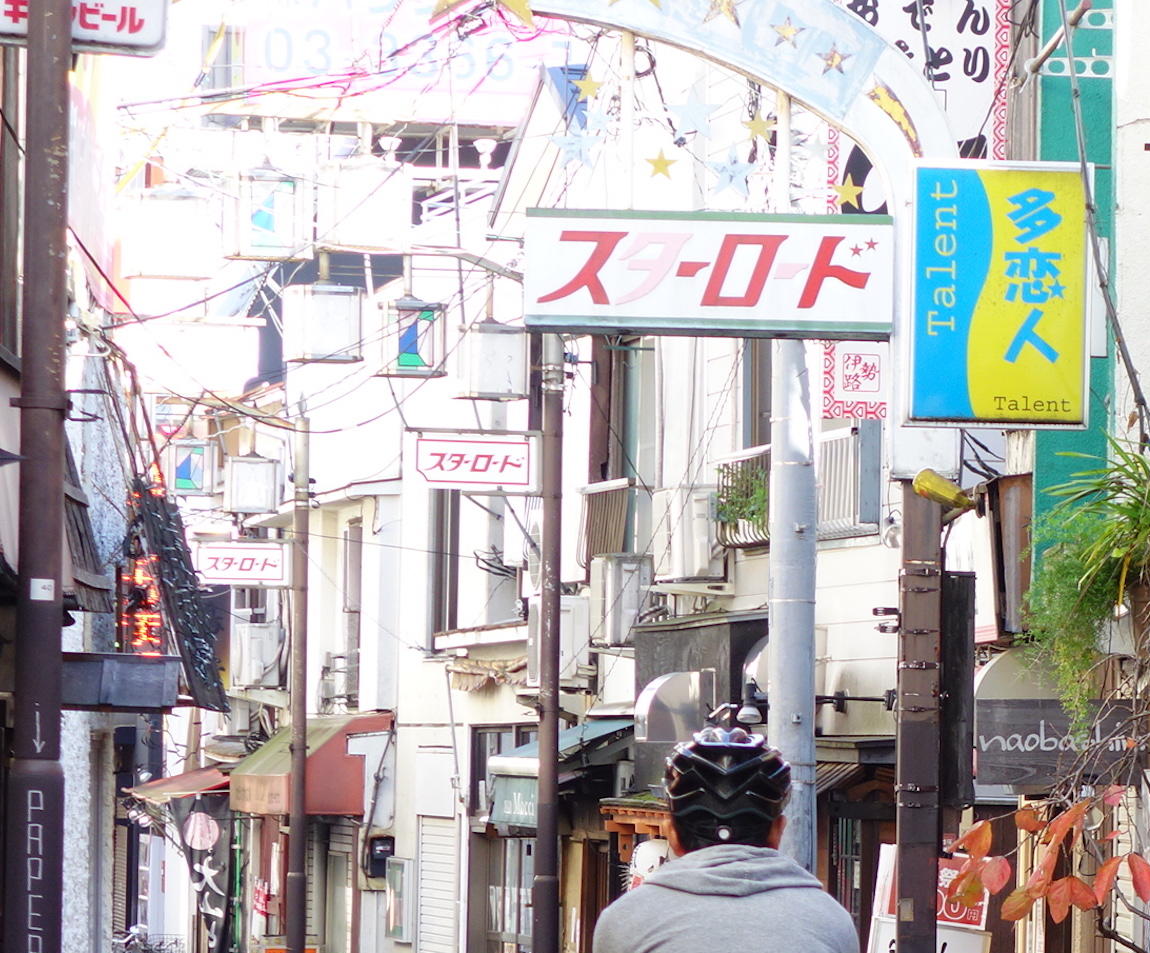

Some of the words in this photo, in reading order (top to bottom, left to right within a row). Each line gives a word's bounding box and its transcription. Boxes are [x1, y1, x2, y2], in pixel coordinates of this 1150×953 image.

[3, 0, 145, 34] キビール
[537, 230, 879, 309] スターロード
[926, 178, 959, 336] Talent
[1002, 188, 1064, 364] 多恋人
[993, 396, 1071, 413] Talent
[424, 452, 525, 473] スターロード
[206, 557, 281, 572] スターロード
